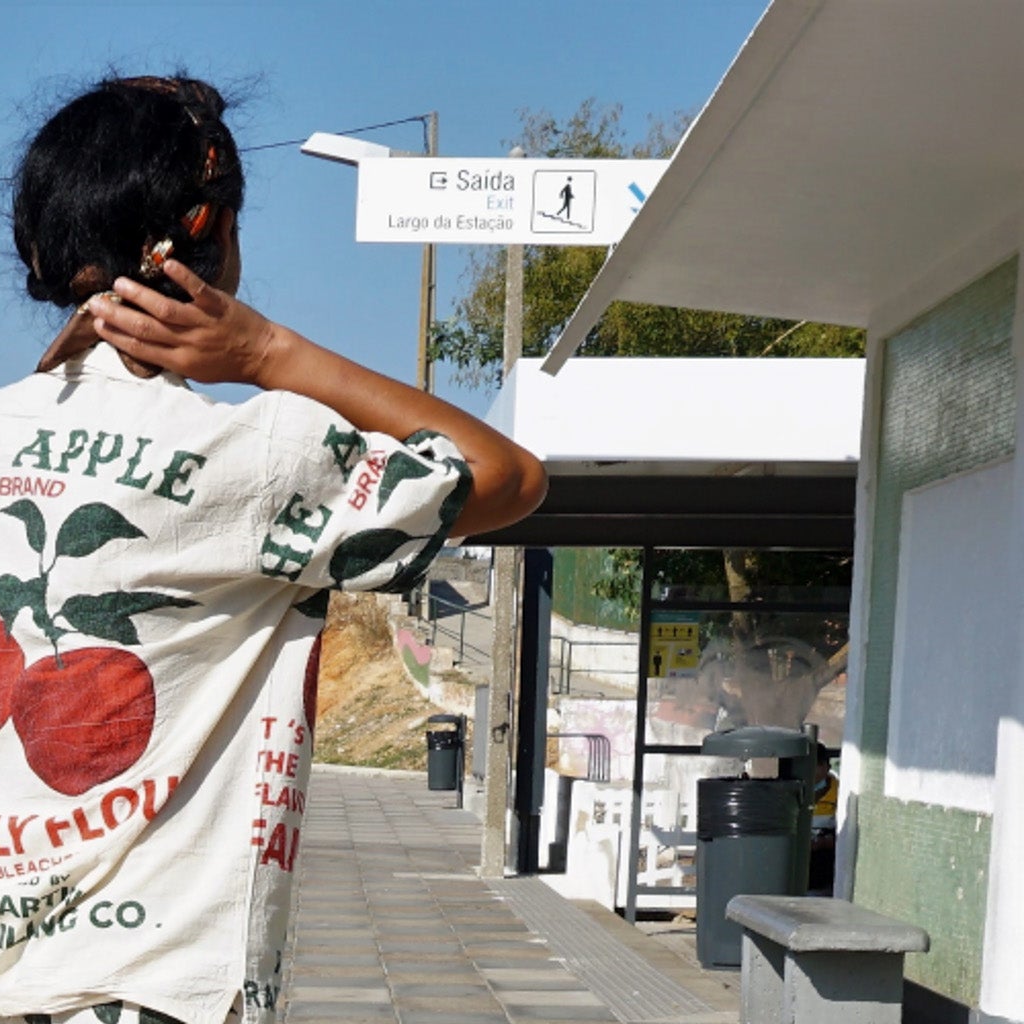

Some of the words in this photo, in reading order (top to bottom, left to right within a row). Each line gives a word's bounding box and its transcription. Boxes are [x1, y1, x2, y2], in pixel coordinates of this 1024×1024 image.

[456, 168, 515, 191] Saída
[487, 196, 514, 210] Exit
[388, 215, 429, 232] Largo
[433, 215, 452, 230] da
[456, 214, 513, 233] Estação
[11, 428, 207, 505] APPLE
